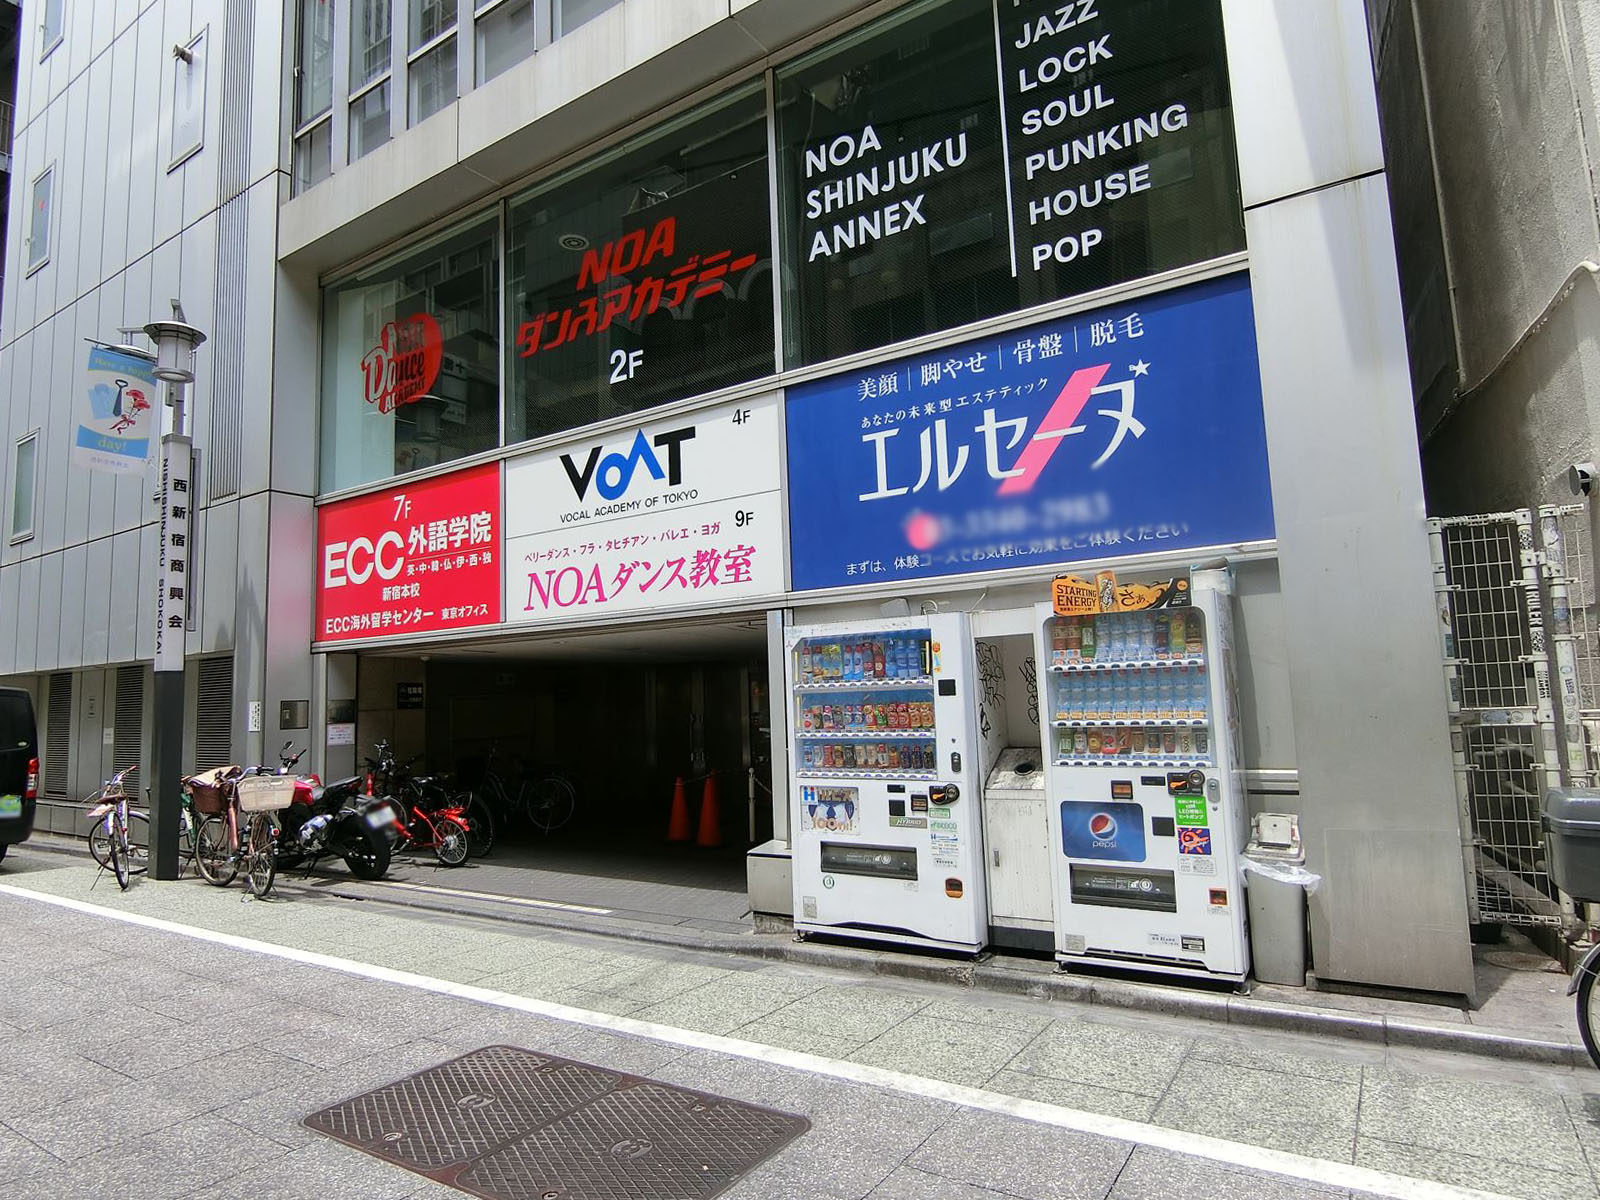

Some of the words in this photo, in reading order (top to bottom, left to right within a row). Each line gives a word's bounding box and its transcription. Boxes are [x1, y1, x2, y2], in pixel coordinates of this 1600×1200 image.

[1015, 0, 1099, 49] JAZZ
[1018, 34, 1113, 93] LOCK
[1021, 85, 1115, 136] SOUL
[805, 125, 882, 178] NOA
[1025, 104, 1189, 181] PUNKING
[806, 132, 968, 220] SHINJUKU
[1028, 163, 1151, 225] HOUSE
[576, 216, 676, 291] NOA
[808, 194, 927, 262] ANNEX
[1032, 229, 1103, 271] POP
[516, 249, 758, 359] ダンスアカデミー
[609, 349, 645, 384] 2F
[857, 371, 898, 402] 美顔
[919, 351, 987, 388] 脚やせ
[1012, 334, 1063, 366] 骨盤
[1090, 312, 1145, 348] 脱毛
[732, 409, 751, 425] 4F
[859, 379, 1148, 502] エルセーヌ
[559, 426, 696, 503] VOAT
[159, 458, 169, 567] NISHISHINJUKU
[393, 494, 411, 522] 7F
[560, 508, 591, 524] VOCAL
[594, 499, 642, 517] ACADEMY
[644, 496, 659, 508] OF
[662, 489, 699, 504] TOKYO
[735, 510, 754, 527] 9F
[168, 478, 187, 629] 西新宿商興会
[324, 530, 405, 589] ECC
[408, 511, 492, 556] 外語学院
[523, 544, 756, 611] NOAダンス教室
[156, 578, 165, 655] SHOKOKAI
[325, 606, 435, 635] ECC海外留学センター
[441, 603, 489, 621] 東京オフィス
[382, 582, 421, 602] 新宿本校
[1056, 584, 1097, 597] STARTING
[1057, 595, 1097, 607] ENERGY
[1092, 840, 1117, 848] pepsi
